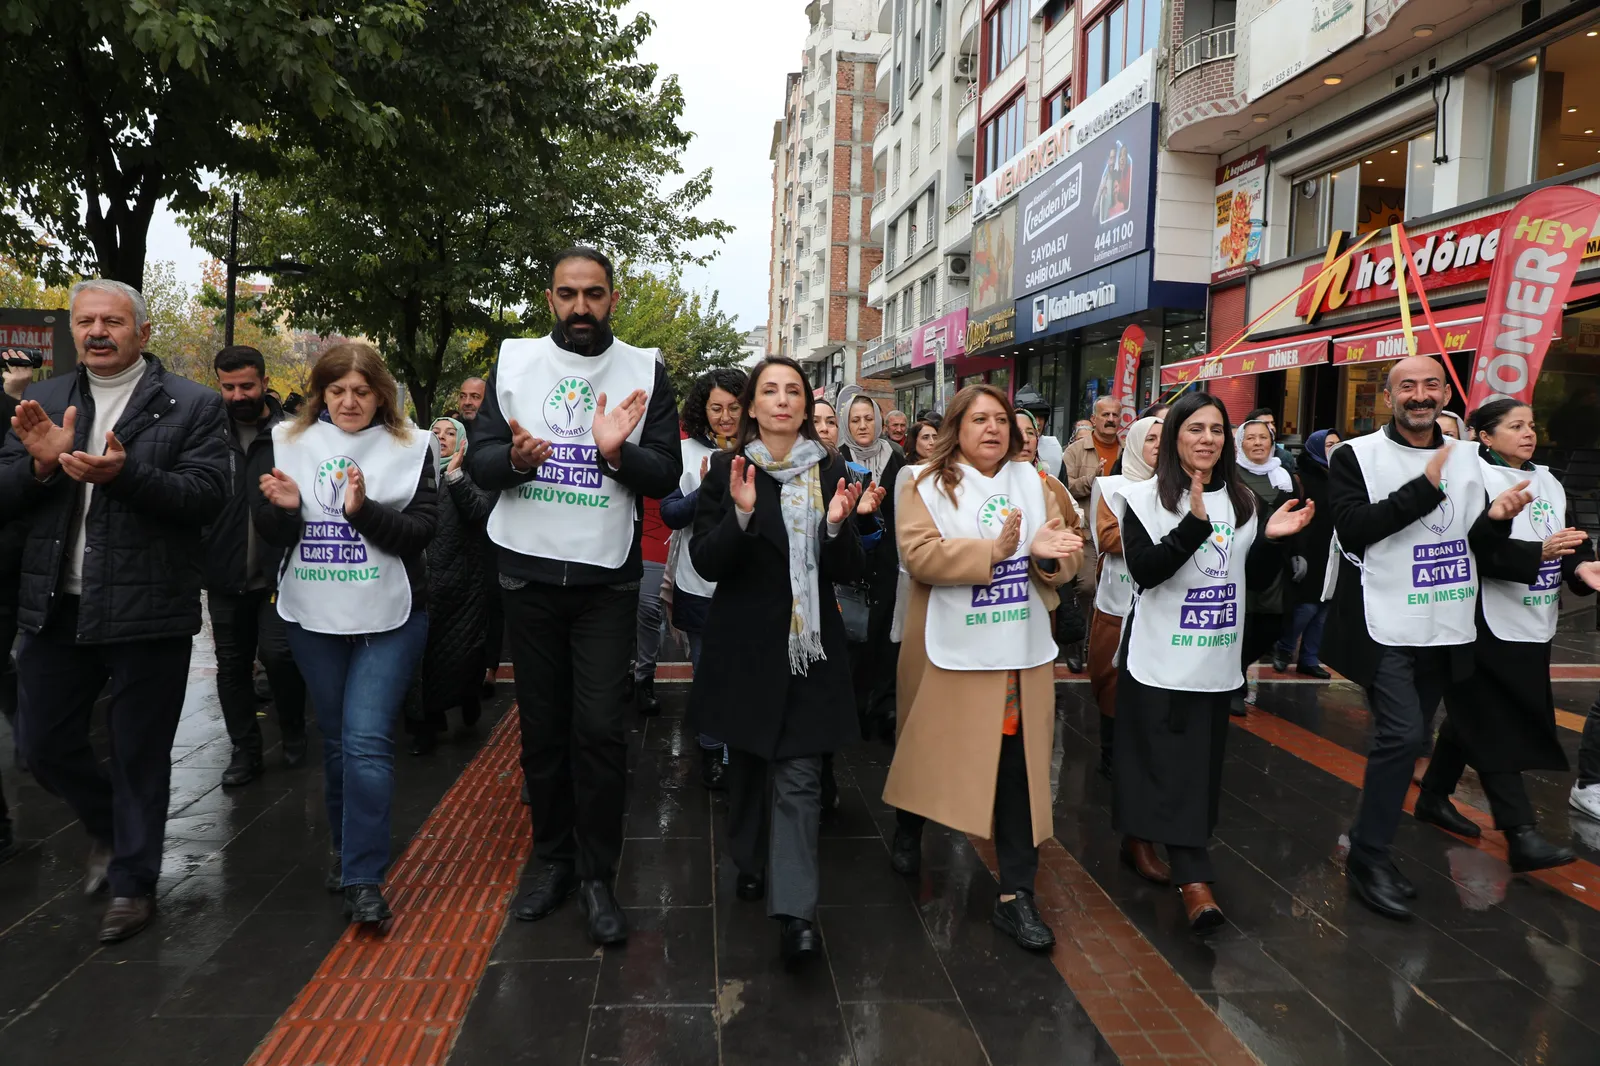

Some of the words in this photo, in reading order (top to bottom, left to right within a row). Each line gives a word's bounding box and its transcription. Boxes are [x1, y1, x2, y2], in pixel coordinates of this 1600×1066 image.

[995, 121, 1075, 202] MEMURKENT
[1061, 176, 1079, 209] iyisi
[1094, 230, 1111, 251] 444
[1112, 228, 1120, 243] 11
[1121, 220, 1134, 240] 00
[1513, 215, 1588, 249] HEY
[1031, 250, 1036, 265] 5
[1036, 239, 1057, 262] AYDA
[1057, 233, 1068, 253] EV
[1356, 227, 1500, 291] heydöne
[1025, 261, 1049, 288] SAHİBİ
[1048, 256, 1072, 280] OLUN.
[11, 329, 53, 346] ARALIK
[1123, 337, 1141, 357] HEY
[1443, 330, 1468, 350] hey
[1268, 349, 1299, 368] DÖNER
[1346, 345, 1365, 362] hey
[549, 446, 577, 461] MEK
[537, 465, 565, 485] ARIŞ
[569, 466, 600, 487] İÇİN
[518, 484, 610, 508] YÜRÜYORUZ
[348, 527, 361, 538] V
[338, 546, 364, 563] İÇİN
[1416, 548, 1425, 558] JI
[1456, 541, 1463, 552] Û
[294, 566, 380, 582] YÜRÜYORUZ
[974, 581, 1029, 604] AŞTIY
[1199, 589, 1214, 599] BO
[1226, 584, 1233, 597] Û
[1408, 592, 1429, 605] EM
[1433, 586, 1475, 602] IMEŞIN
[1523, 595, 1541, 606] EM
[965, 611, 988, 626] EM
[1171, 634, 1193, 646] EM
[1197, 632, 1238, 648] DIMEŞIN
